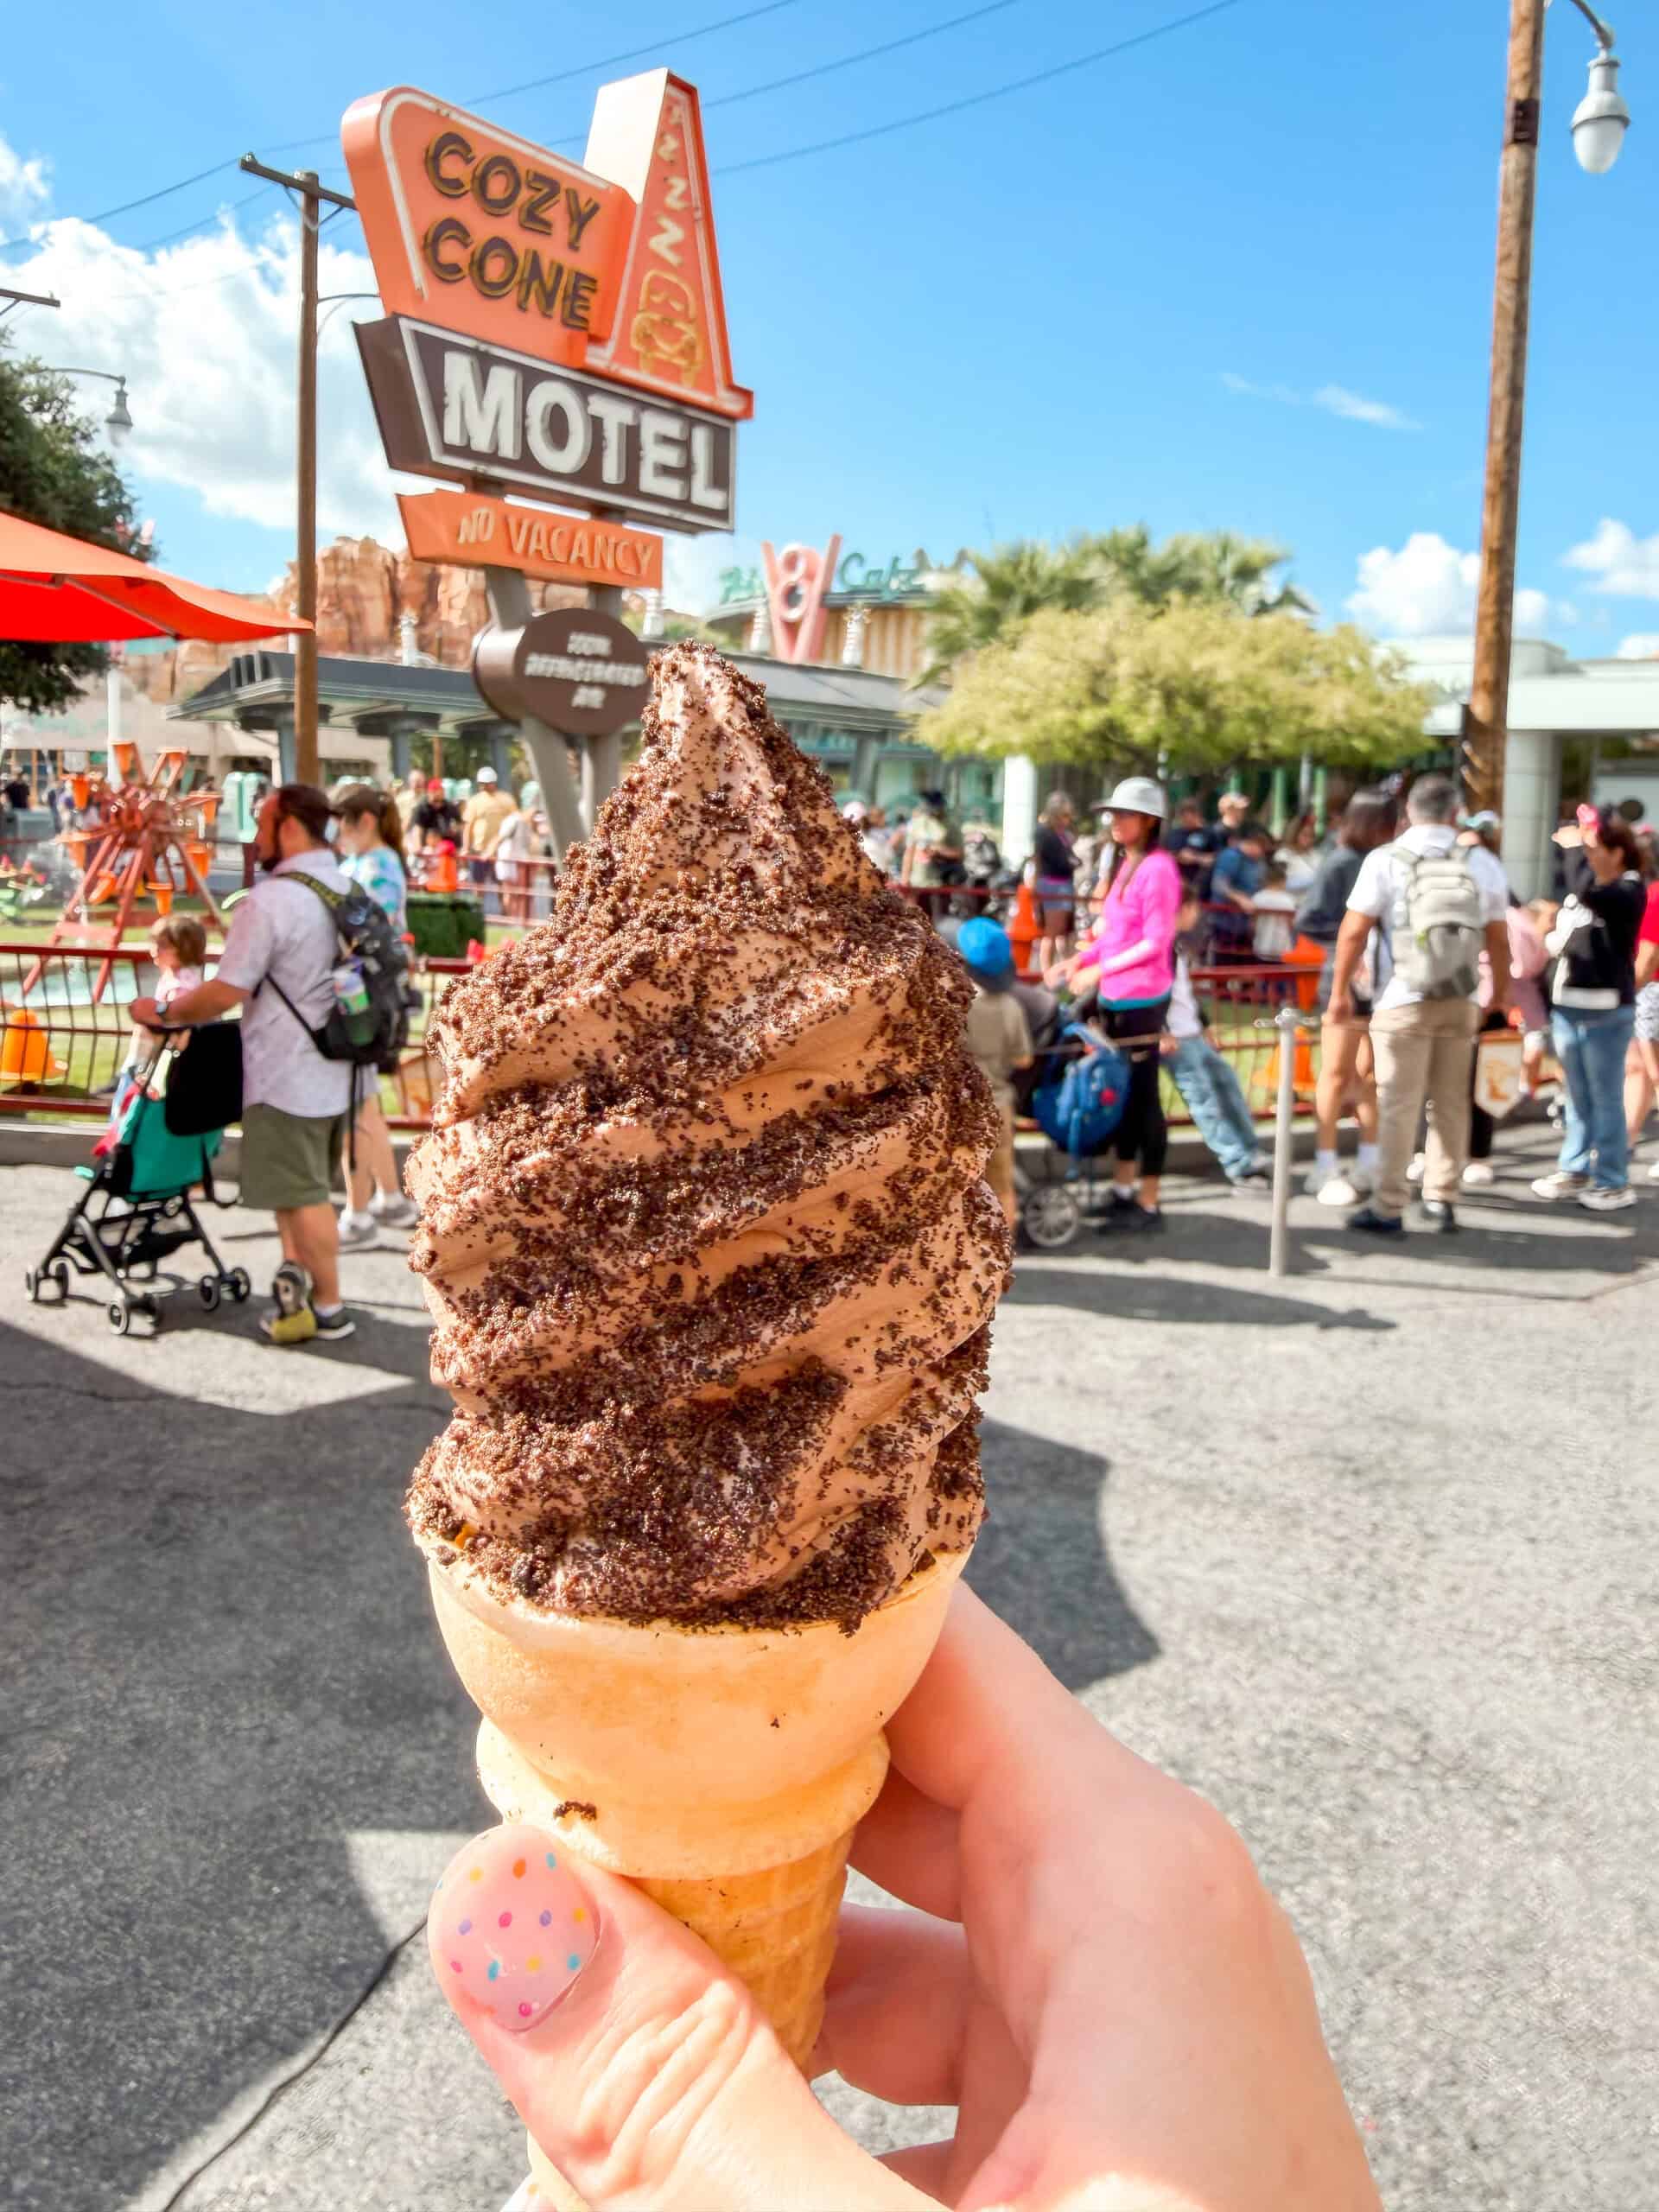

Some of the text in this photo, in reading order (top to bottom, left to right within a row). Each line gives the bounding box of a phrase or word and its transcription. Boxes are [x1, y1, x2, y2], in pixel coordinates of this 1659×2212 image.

[424, 131, 601, 251] COZY
[423, 216, 598, 333] CONE
[442, 351, 728, 510] MOTEL
[457, 506, 654, 575] NO VACANCY
